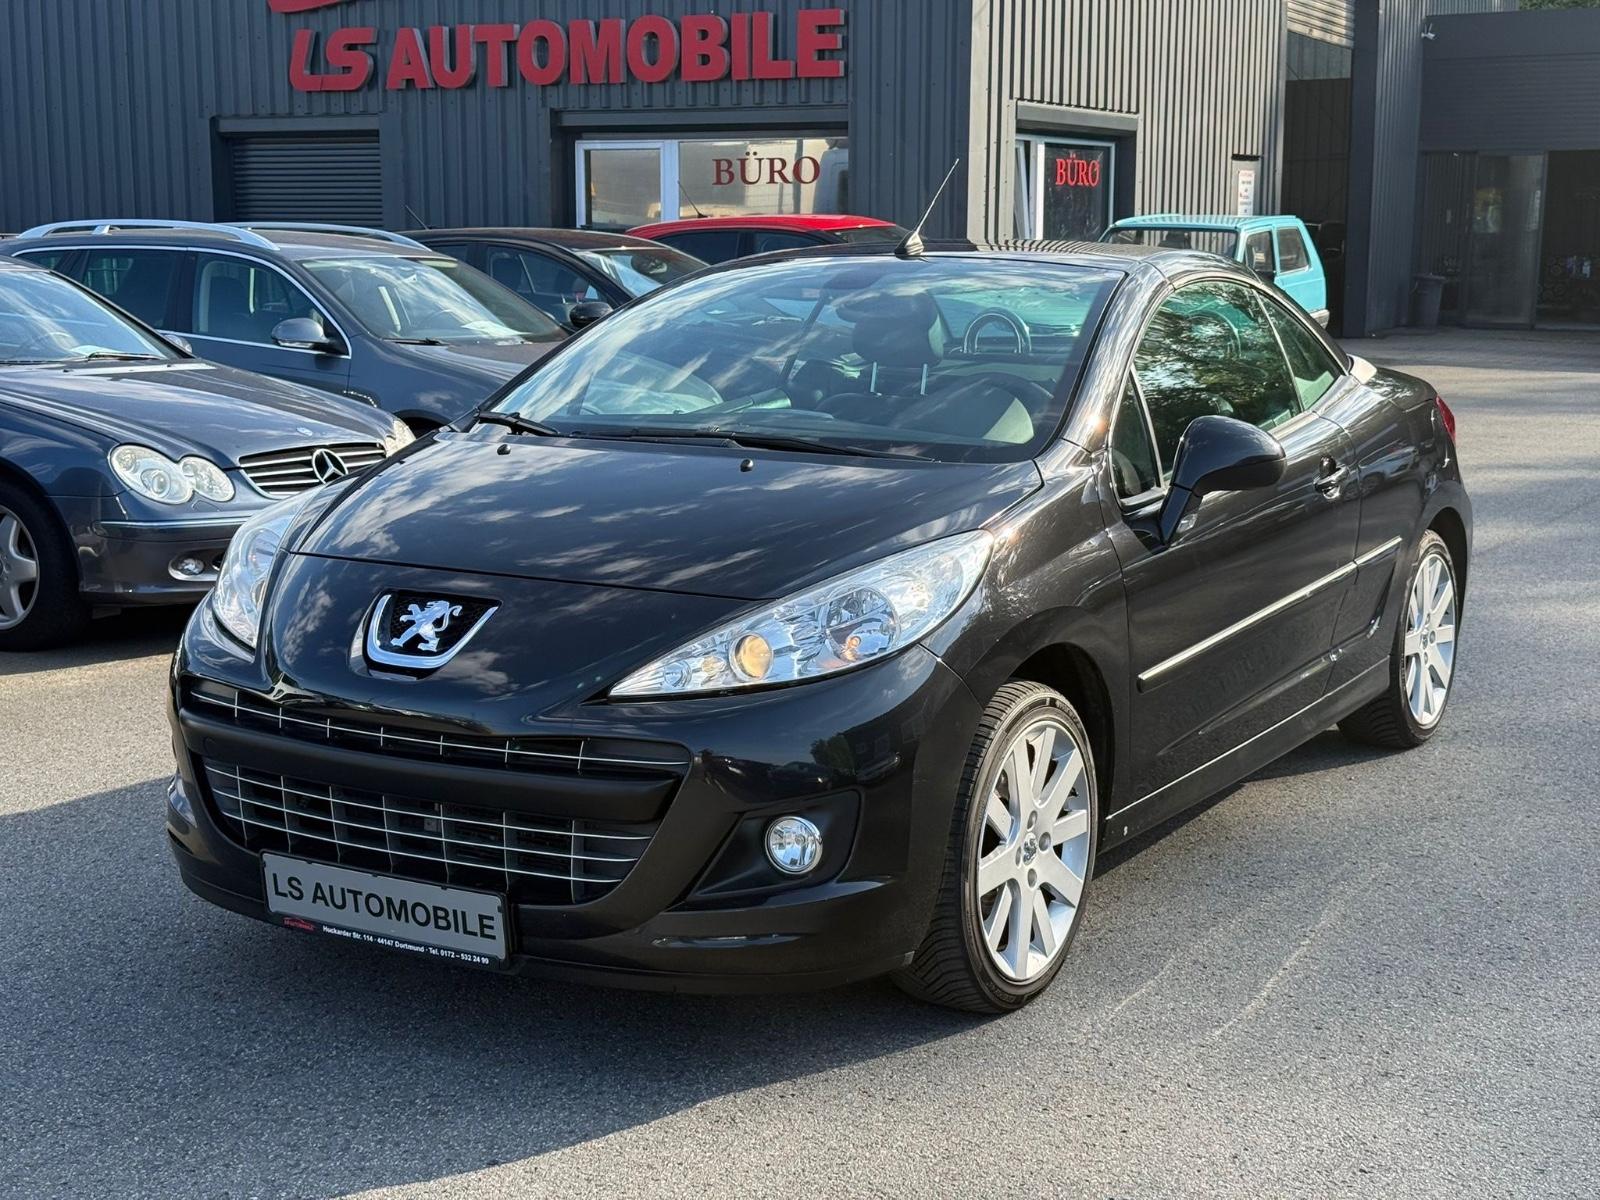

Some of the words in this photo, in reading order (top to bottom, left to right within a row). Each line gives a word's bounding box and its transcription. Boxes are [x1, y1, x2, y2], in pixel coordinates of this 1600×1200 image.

[289, 27, 378, 92] LS
[385, 8, 846, 90] AUTOMOBILE
[712, 151, 821, 186] BÜRO
[1055, 153, 1100, 187] BÜRO
[272, 873, 304, 901] LS
[311, 881, 497, 940] AUTOMOBILE
[394, 941, 424, 953] Dortmund
[429, 947, 439, 956] Tel.
[440, 949, 455, 958] 0172
